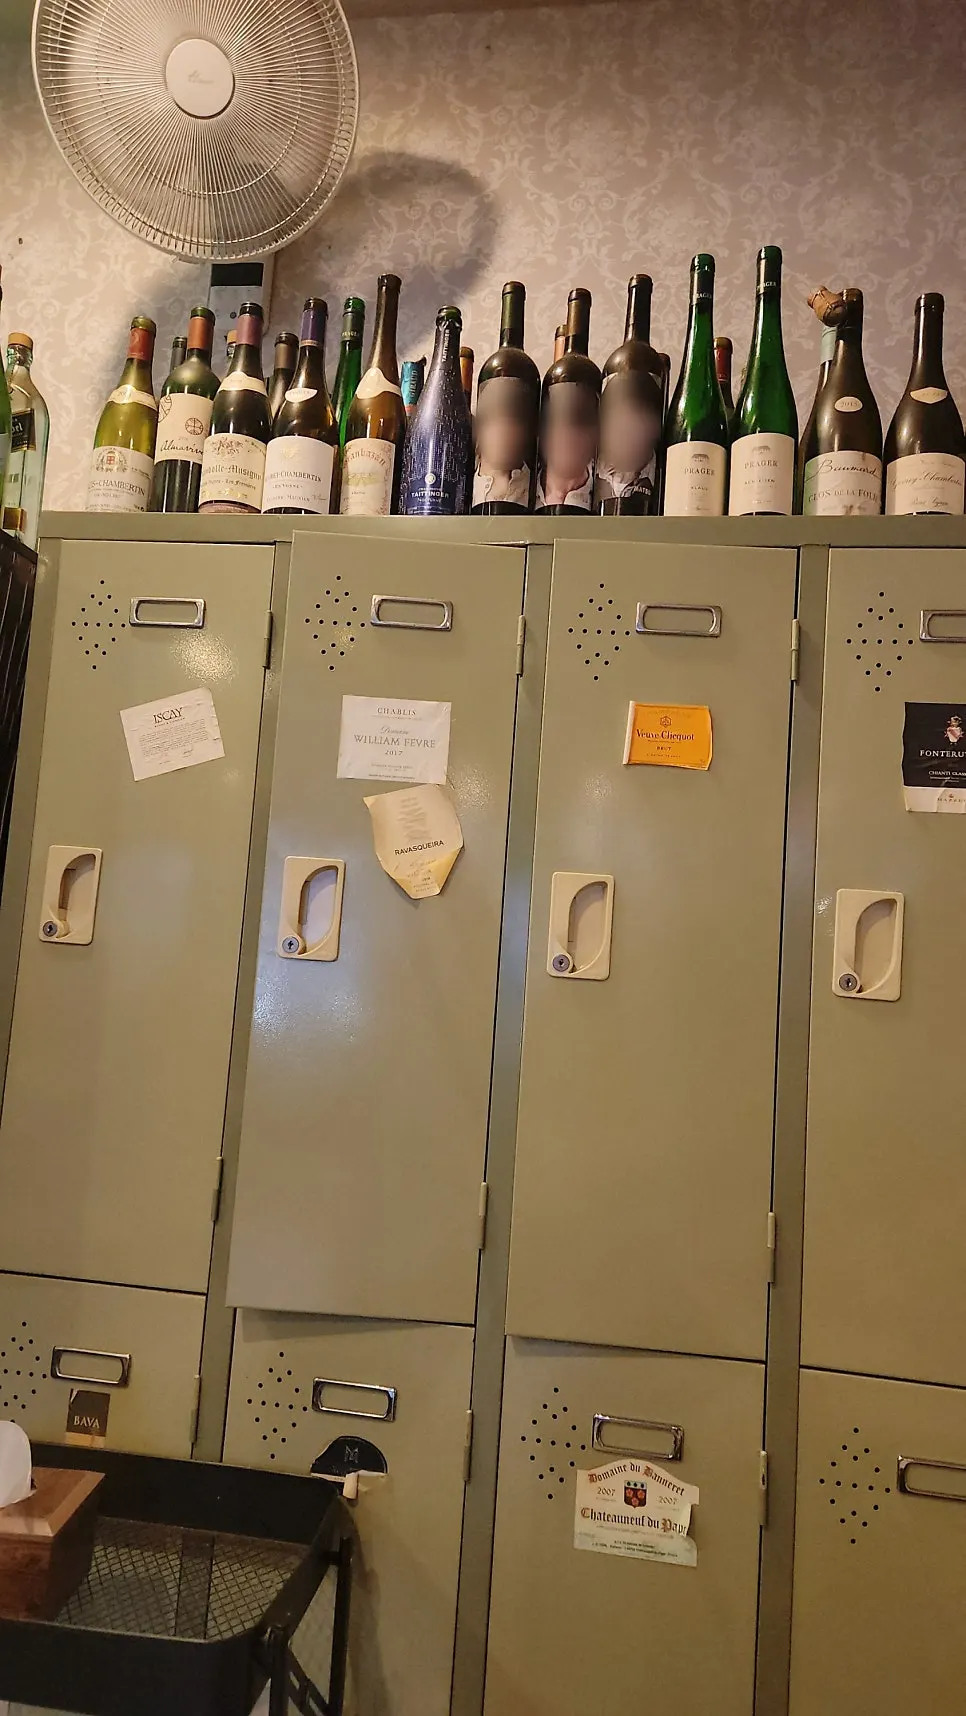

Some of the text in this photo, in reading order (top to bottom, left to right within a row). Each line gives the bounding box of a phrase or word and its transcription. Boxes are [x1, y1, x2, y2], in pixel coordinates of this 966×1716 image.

[744, 459, 779, 470] PRAGER
[684, 467, 716, 477] PRAGER
[411, 491, 450, 499] TAITTINGER
[153, 706, 183, 724] ISCAY
[377, 707, 417, 716] CHABLIS
[353, 734, 400, 746] WILLIAM
[636, 728, 695, 742] Veuve Clicquot
[919, 749, 966, 758] FONTERU
[394, 840, 445, 856] RAVASQUEIRA
[73, 1415, 100, 1429] BAVA
[587, 1462, 685, 1496] Domaine du Banneret
[597, 1486, 616, 1497] 2007
[647, 1516, 660, 1529] du
